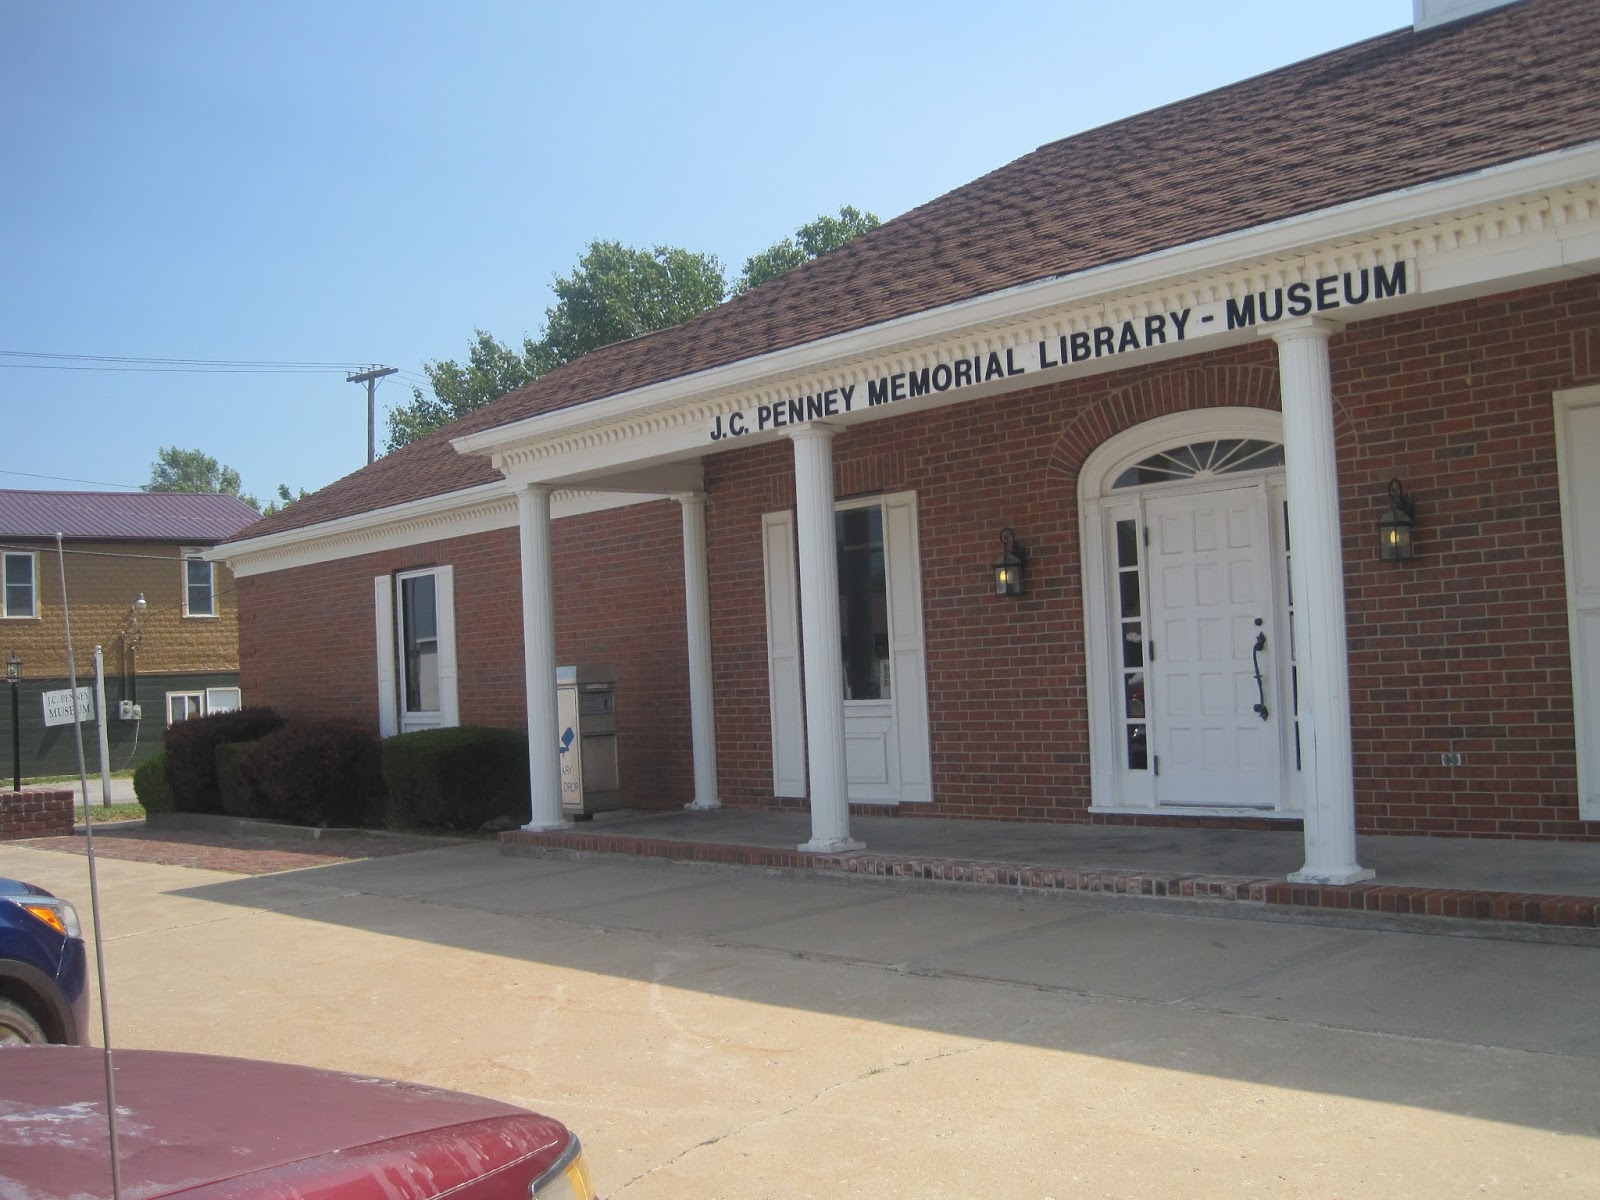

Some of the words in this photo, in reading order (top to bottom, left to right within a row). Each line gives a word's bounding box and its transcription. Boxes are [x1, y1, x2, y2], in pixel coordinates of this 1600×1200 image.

[710, 411, 749, 441] J.C.
[758, 385, 855, 430] PENNEY
[867, 348, 1025, 406] MEMORIAL
[1039, 308, 1191, 369] LIBRARY
[1226, 260, 1407, 330] MUSEUM
[48, 703, 91, 719] MUSEM
